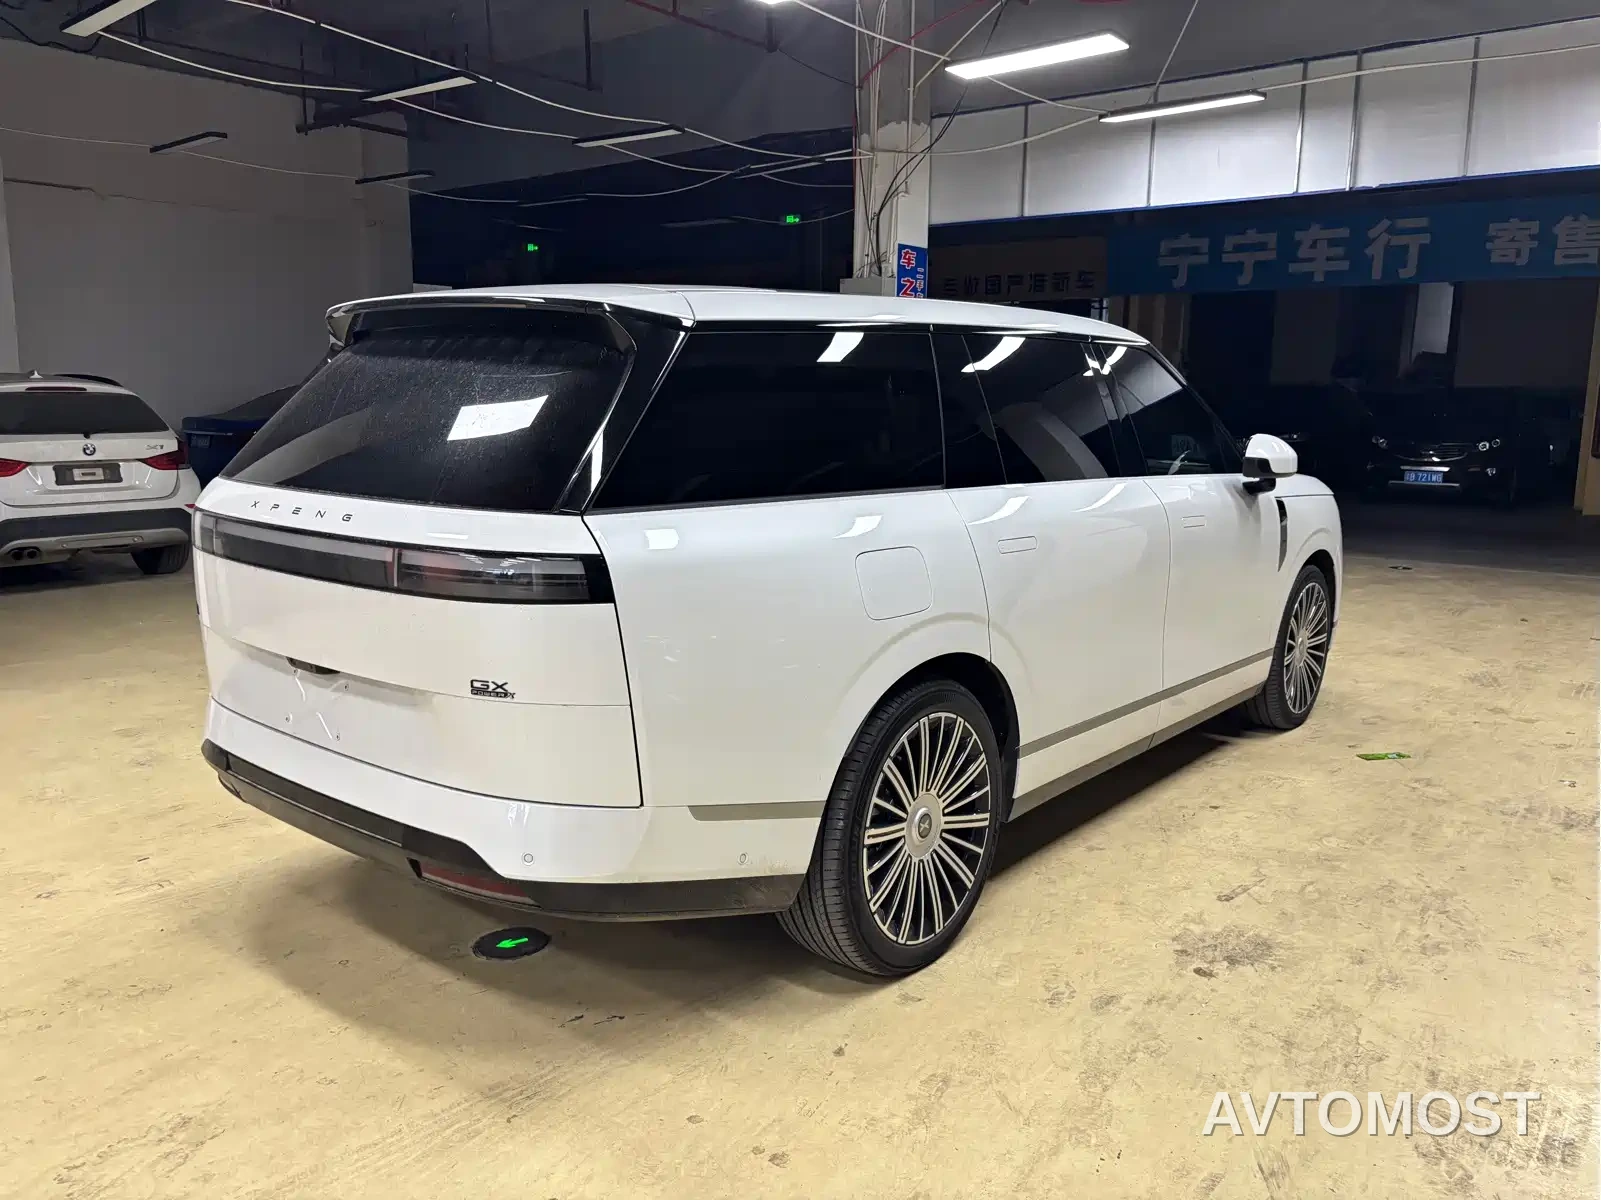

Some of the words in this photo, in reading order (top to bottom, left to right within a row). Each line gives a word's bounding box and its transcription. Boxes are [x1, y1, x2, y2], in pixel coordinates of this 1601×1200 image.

[1157, 216, 1431, 289] 宁宁车行
[1485, 213, 1599, 266] 寄售
[250, 500, 353, 522] XPENG
[470, 679, 508, 692] GX
